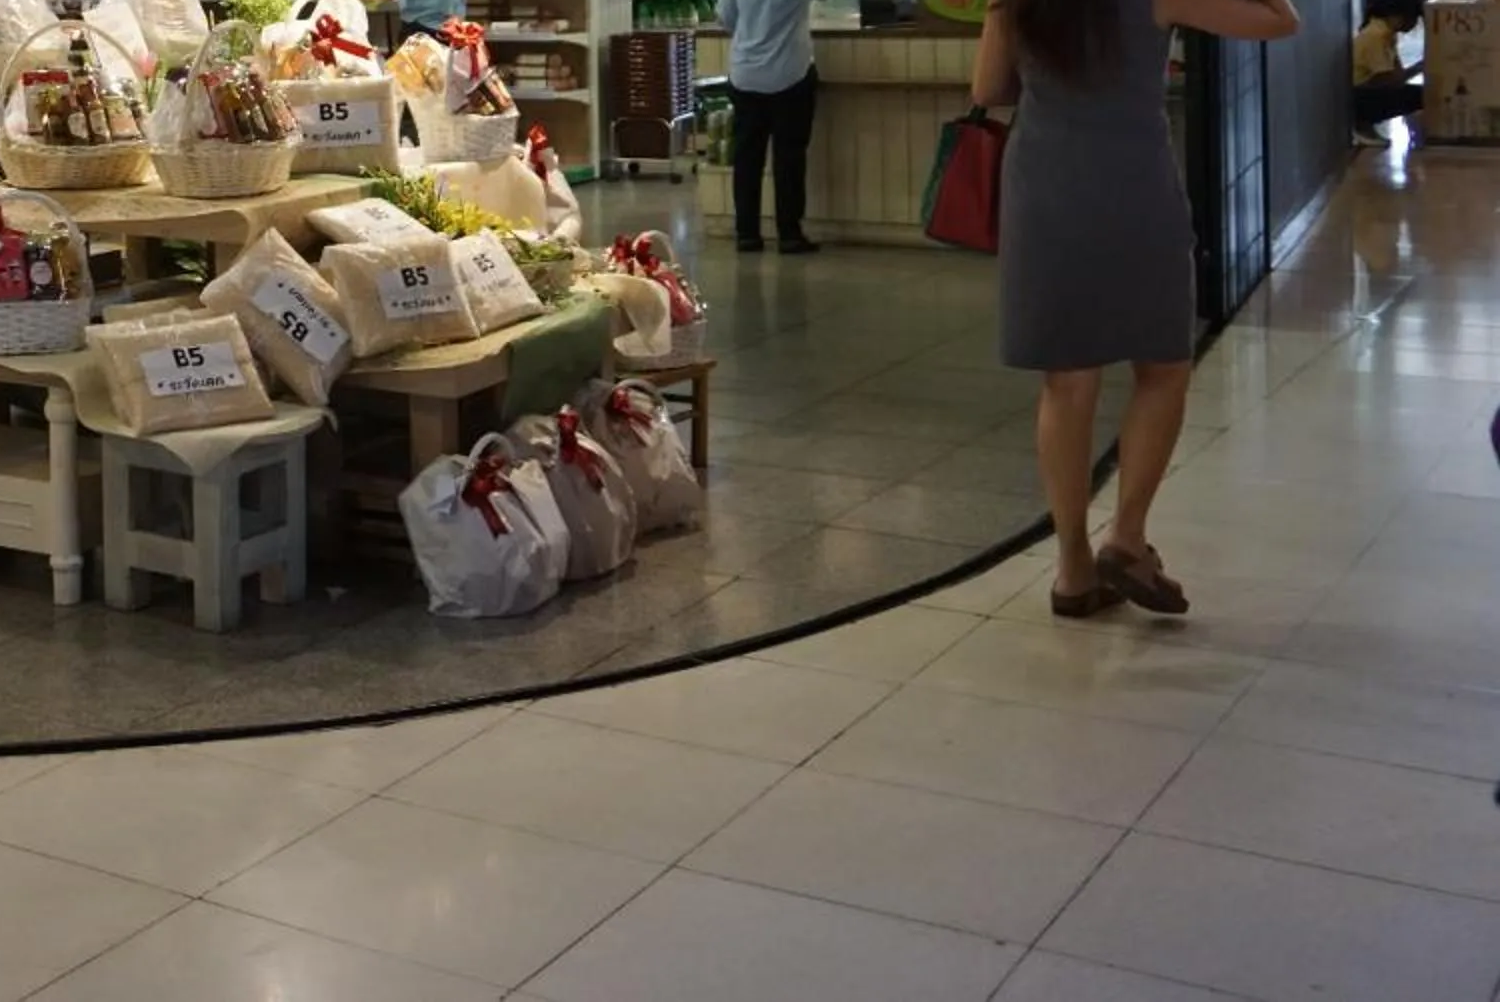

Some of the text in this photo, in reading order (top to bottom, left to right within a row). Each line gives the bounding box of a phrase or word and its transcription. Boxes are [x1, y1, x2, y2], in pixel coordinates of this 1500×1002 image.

[319, 101, 349, 121] B5
[400, 265, 430, 288] B5
[279, 310, 309, 343] B5
[172, 346, 205, 369] B5
